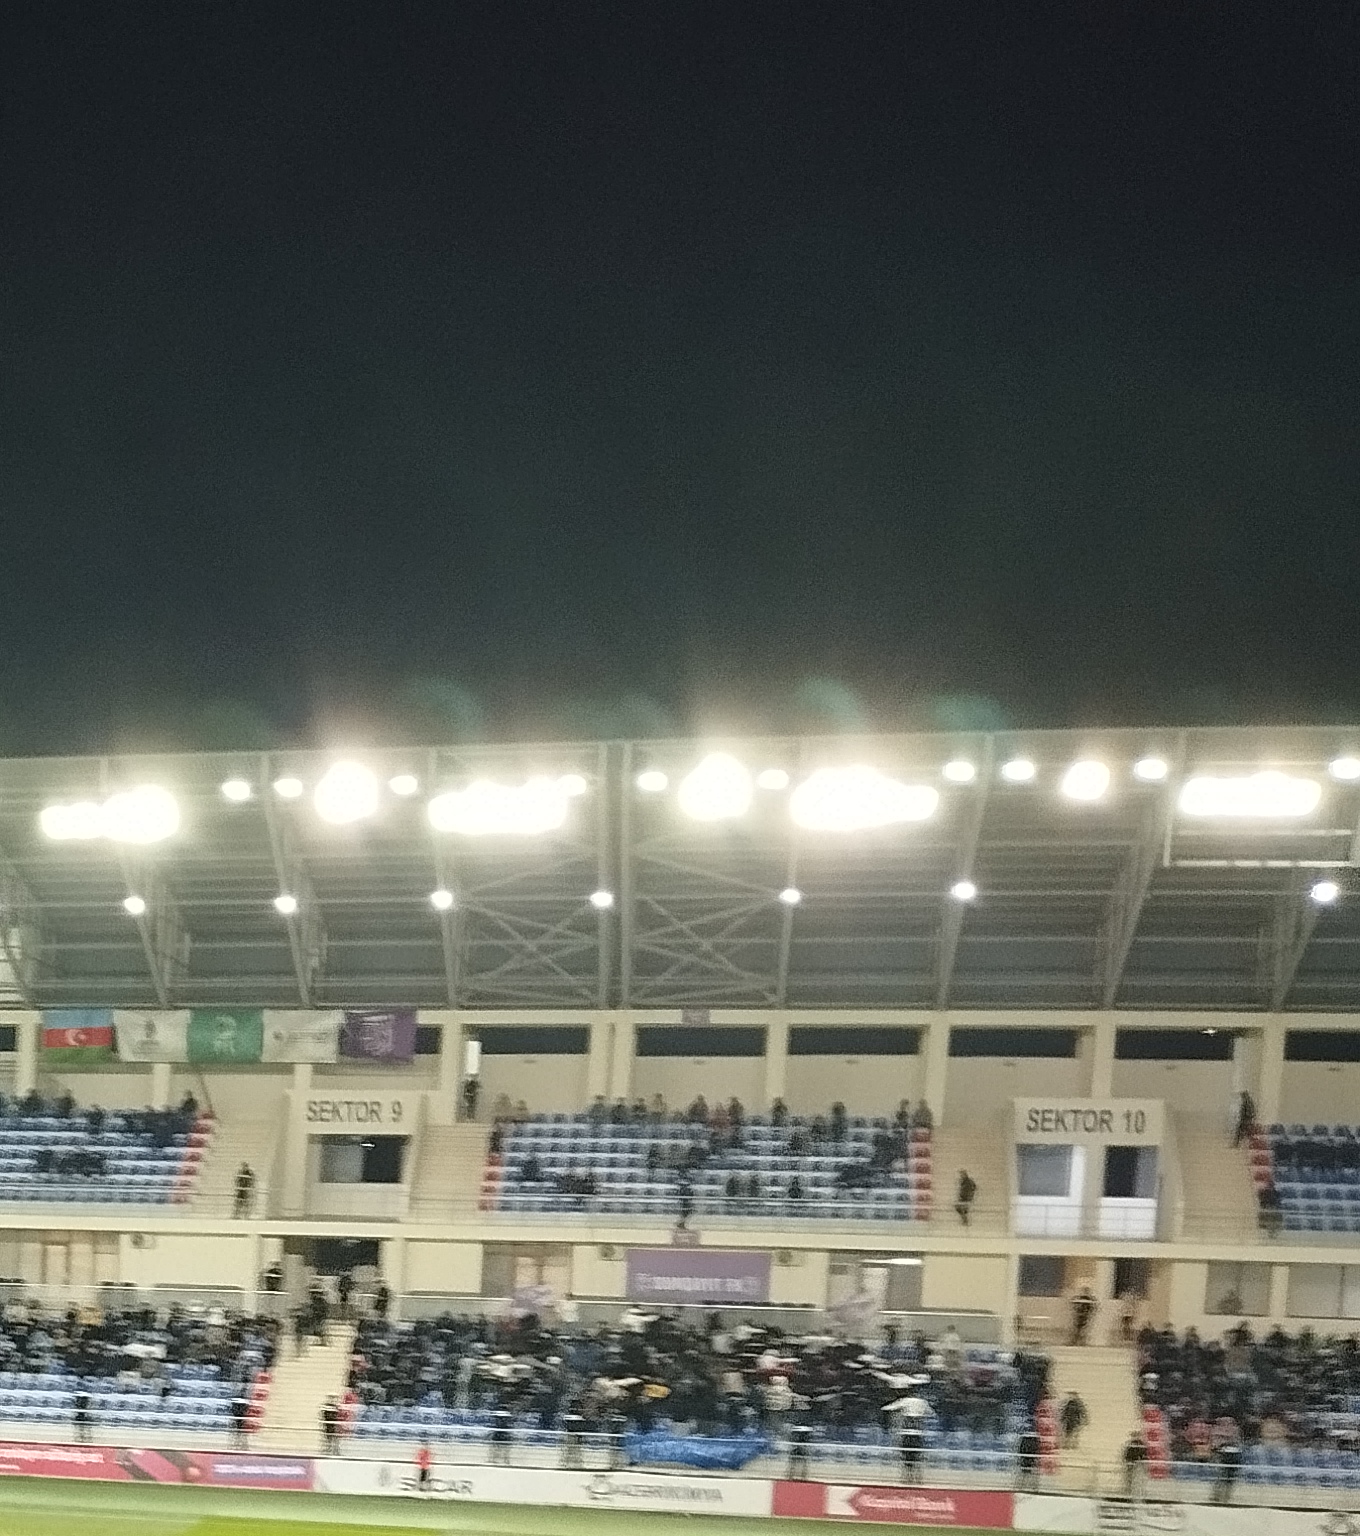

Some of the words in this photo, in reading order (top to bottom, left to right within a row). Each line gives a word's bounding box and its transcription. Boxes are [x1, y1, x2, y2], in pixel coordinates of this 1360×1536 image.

[306, 1100, 382, 1122] SEKTOR
[391, 1101, 402, 1122] 9
[1026, 1107, 1113, 1133] SEKTOR
[1122, 1109, 1145, 1134] 10
